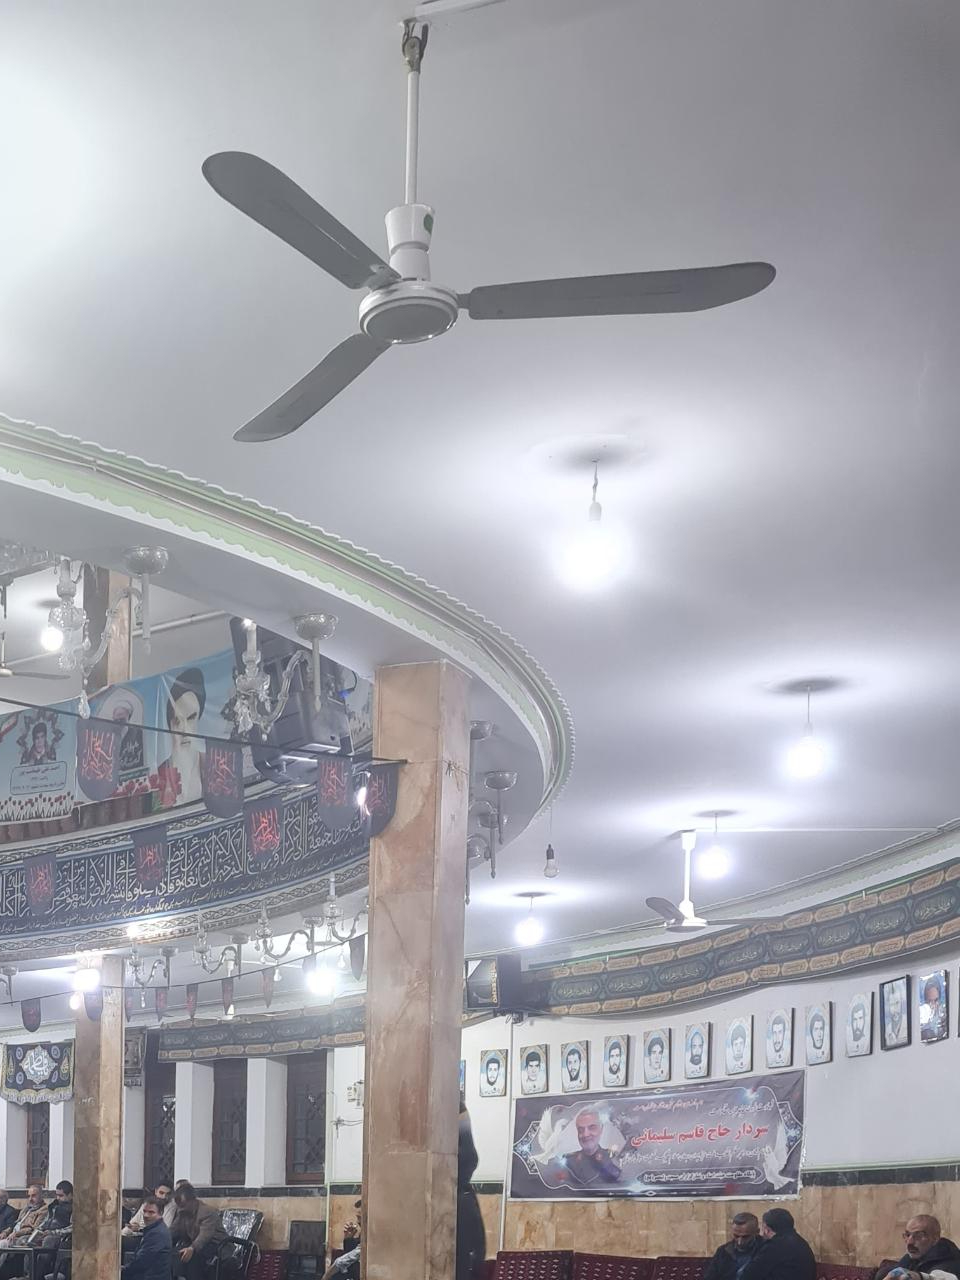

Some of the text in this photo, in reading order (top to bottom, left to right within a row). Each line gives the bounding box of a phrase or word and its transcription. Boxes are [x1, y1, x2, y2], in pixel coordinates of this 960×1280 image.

[631, 1122, 769, 1147] سردار حاج قاسم سلیمانی
